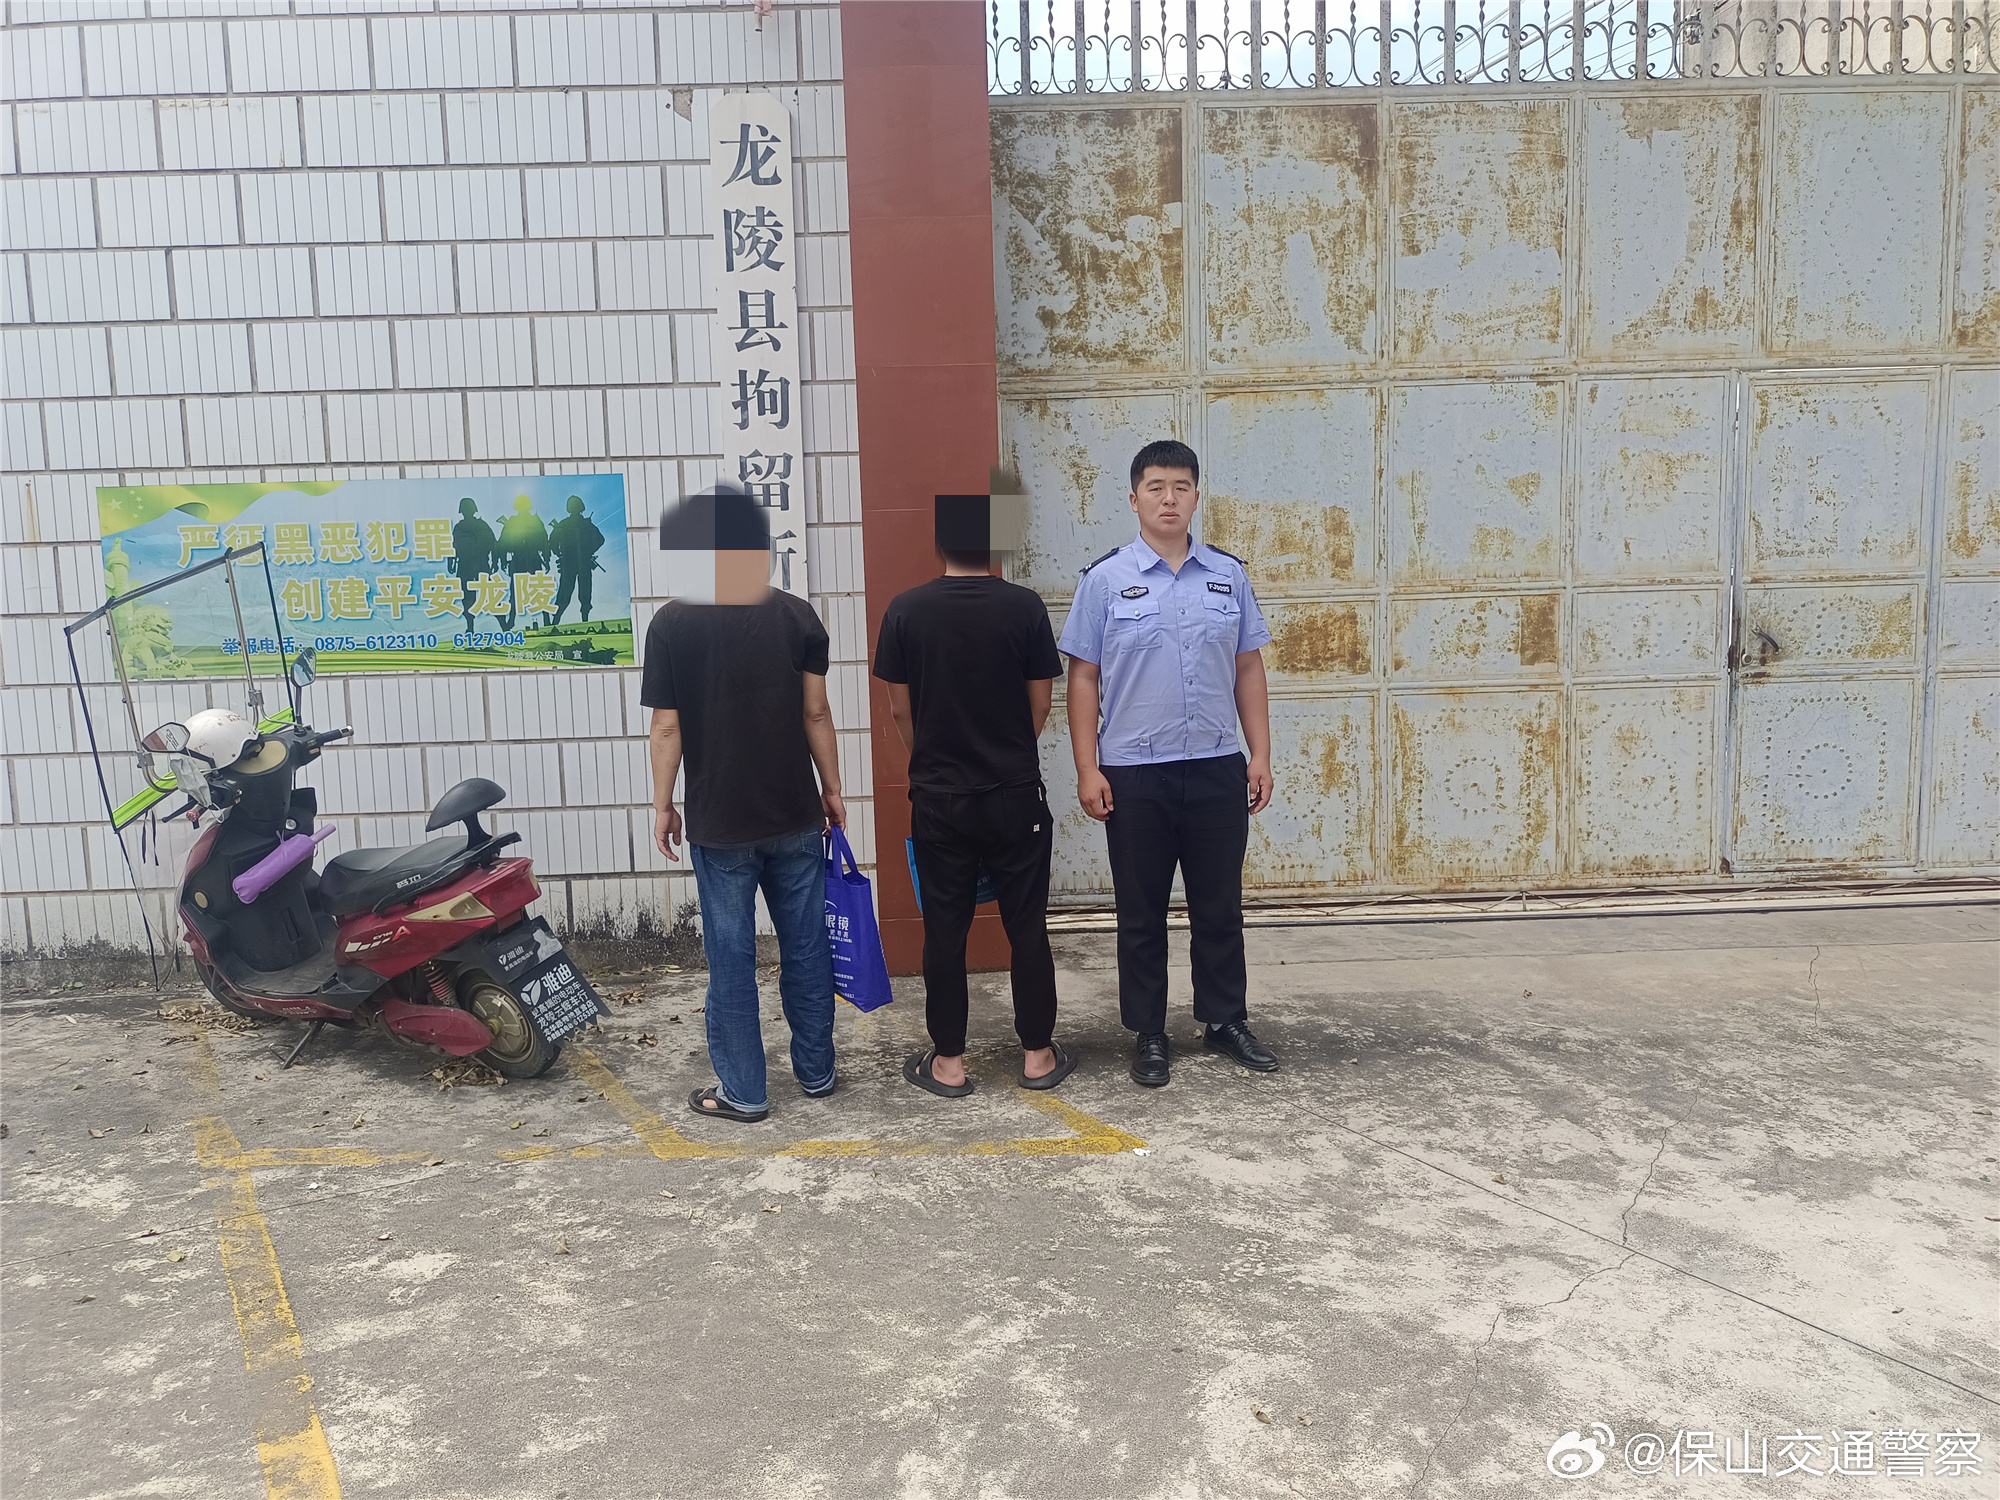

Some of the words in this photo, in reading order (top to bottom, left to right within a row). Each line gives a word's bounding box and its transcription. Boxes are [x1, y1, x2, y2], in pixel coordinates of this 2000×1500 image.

[177, 518, 456, 568] 严惩黑恶犯罪
[282, 571, 559, 620] 创建平安龙陵
[314, 632, 438, 652] 0875-6123110
[452, 630, 526, 648] 6127904
[505, 650, 564, 661] 龙陵县公安局
[572, 649, 583, 660] 宣
[541, 962, 576, 996] 雅迪
[531, 980, 582, 1019] 更高端的电动车
